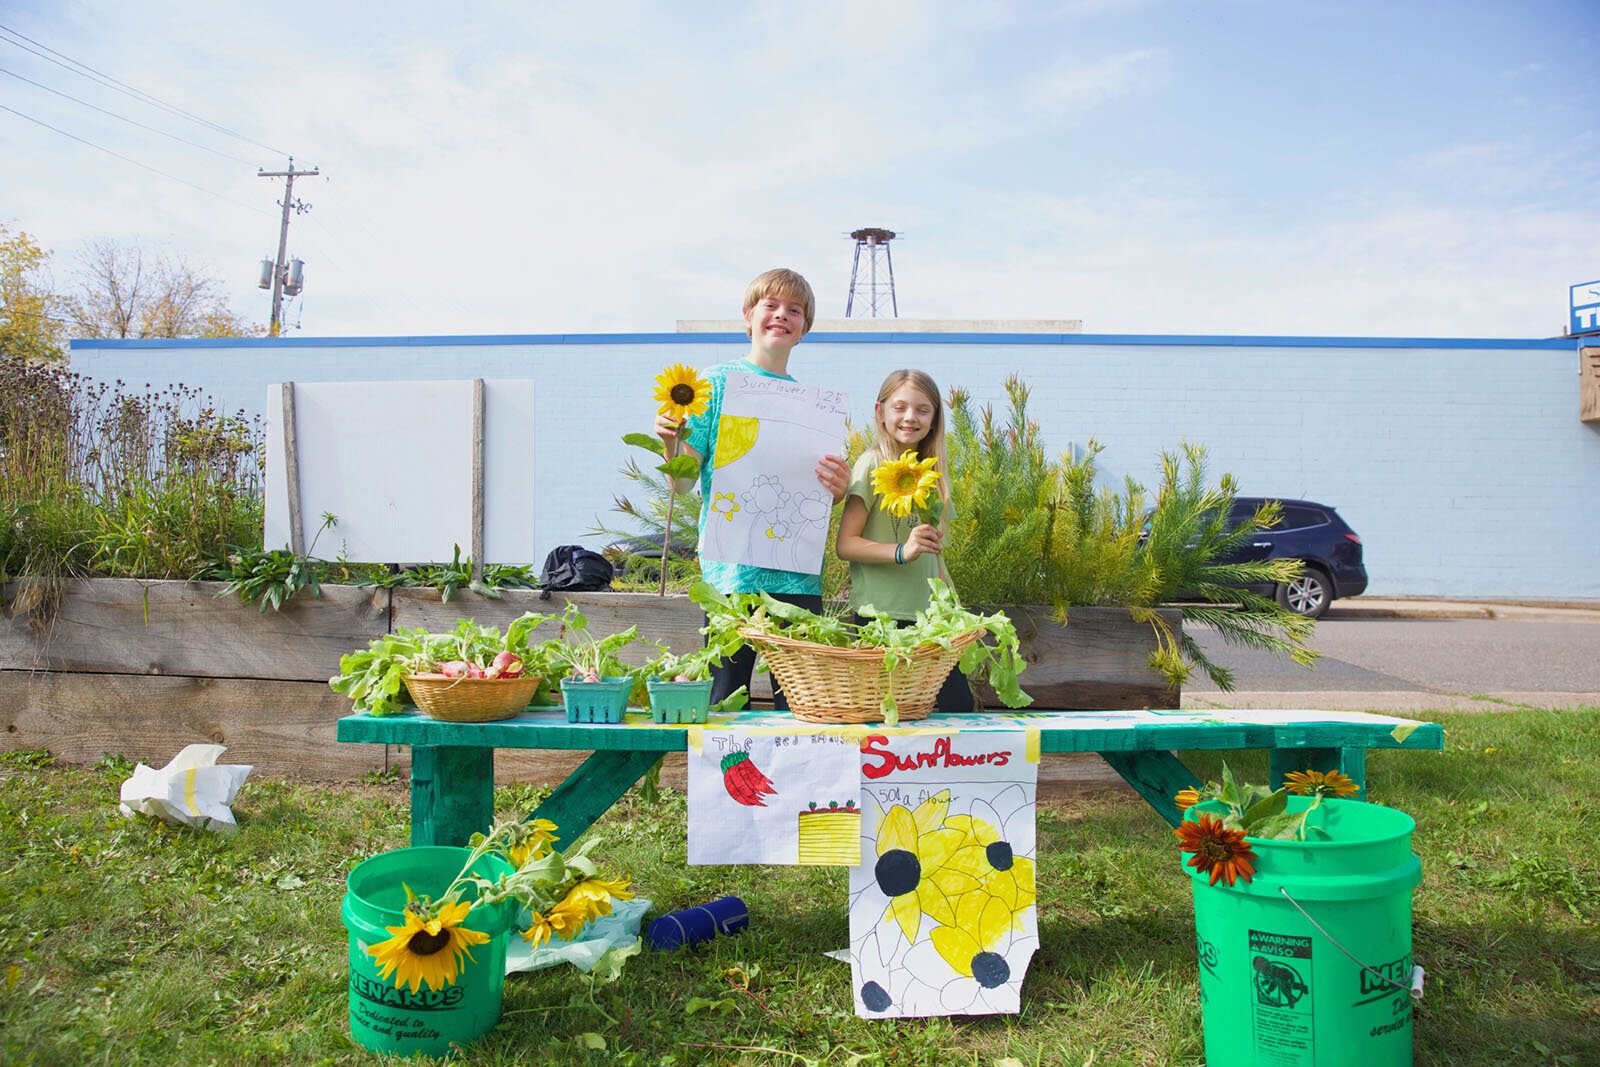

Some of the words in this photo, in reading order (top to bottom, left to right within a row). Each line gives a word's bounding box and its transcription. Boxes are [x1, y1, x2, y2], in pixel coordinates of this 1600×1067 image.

[712, 735, 753, 752] The
[860, 734, 1012, 779] Sunflowers
[917, 788, 960, 805] flower
[1258, 933, 1310, 948] WARNING
[1260, 945, 1294, 957] AVISO
[359, 1002, 409, 1027] Dedicated
[413, 1019, 424, 1028] to
[373, 1025, 393, 1036] and
[395, 1028, 440, 1041] quality
